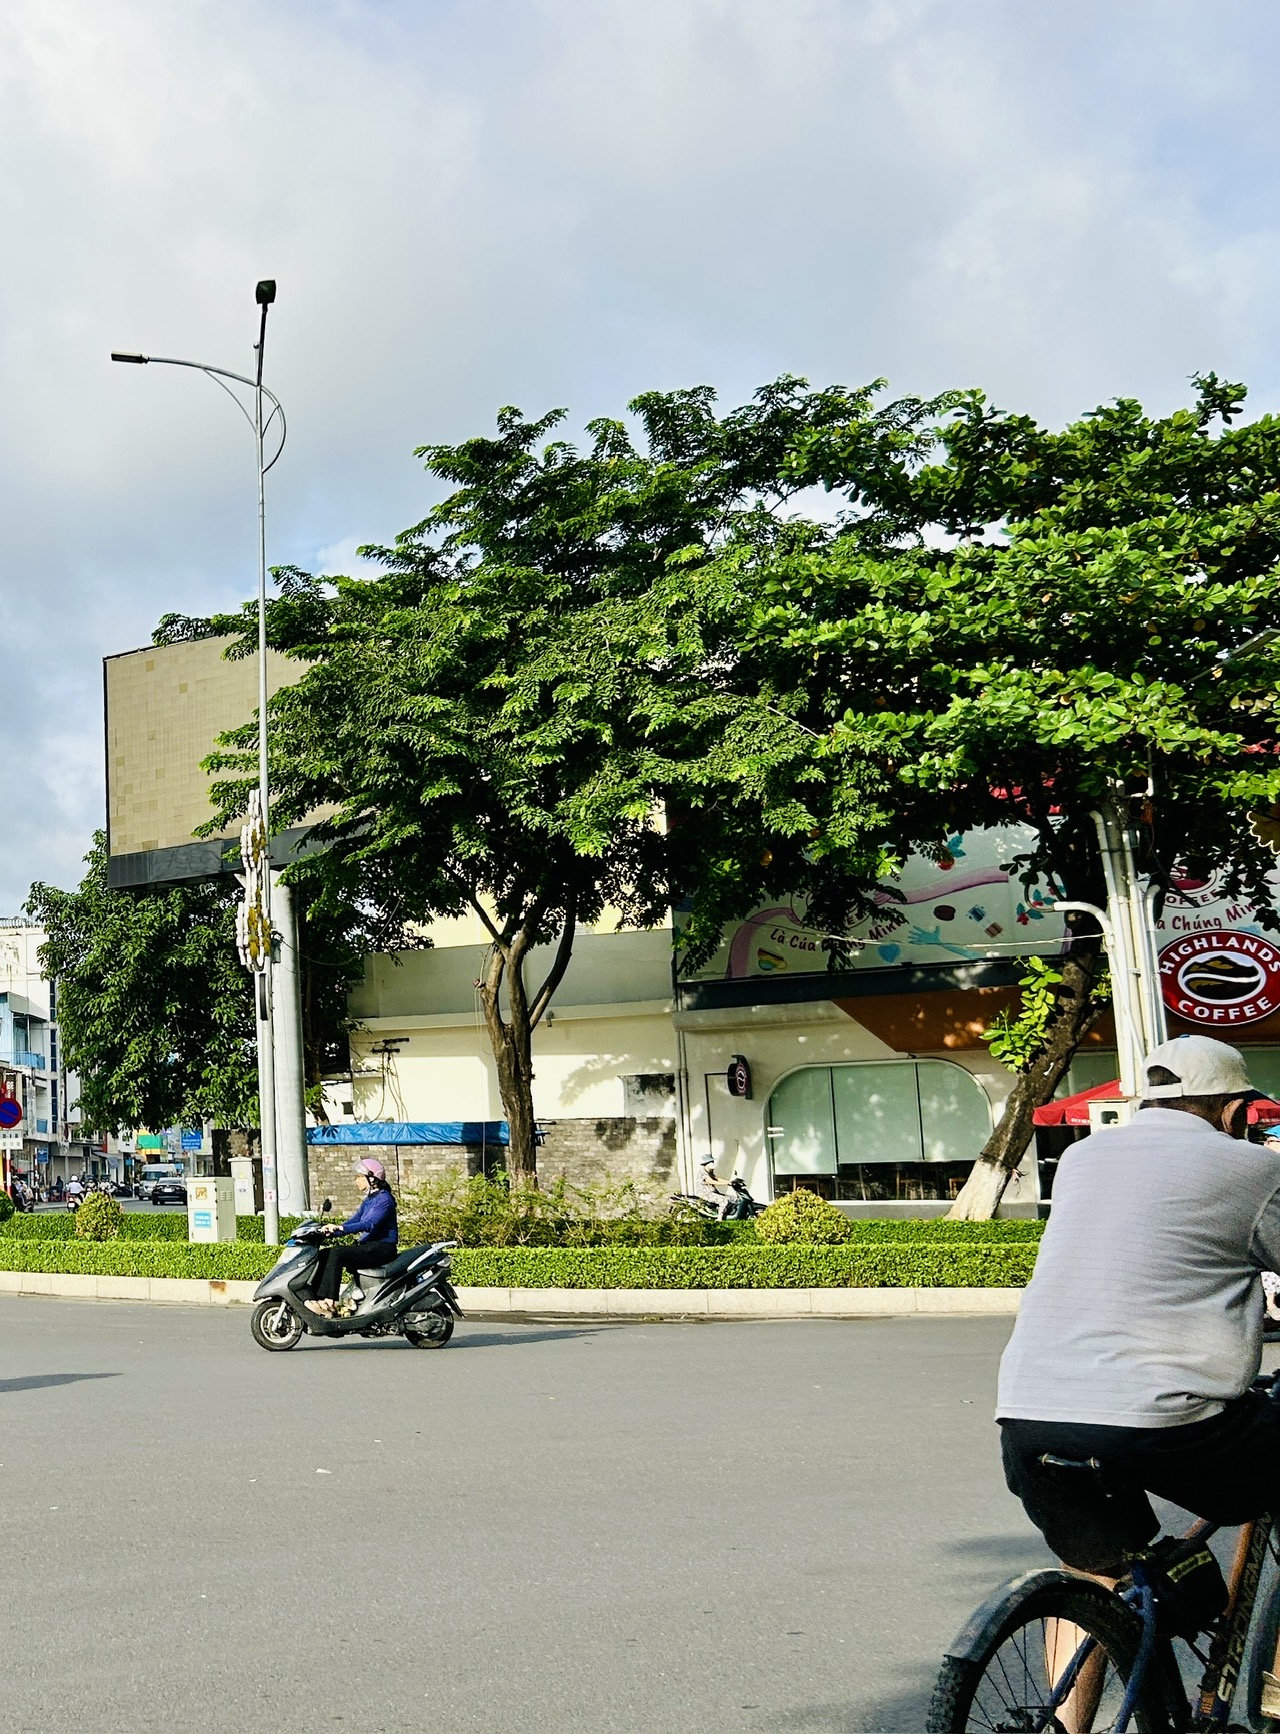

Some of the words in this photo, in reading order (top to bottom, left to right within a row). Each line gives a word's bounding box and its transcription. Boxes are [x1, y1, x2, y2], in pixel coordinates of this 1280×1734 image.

[1172, 914, 1222, 931] Chúng
[1225, 903, 1258, 922] Mìn
[770, 928, 785, 944] Là
[789, 934, 816, 951] Của
[1160, 936, 1280, 975] HIGHLANDS
[1178, 997, 1272, 1020] COFFEE
